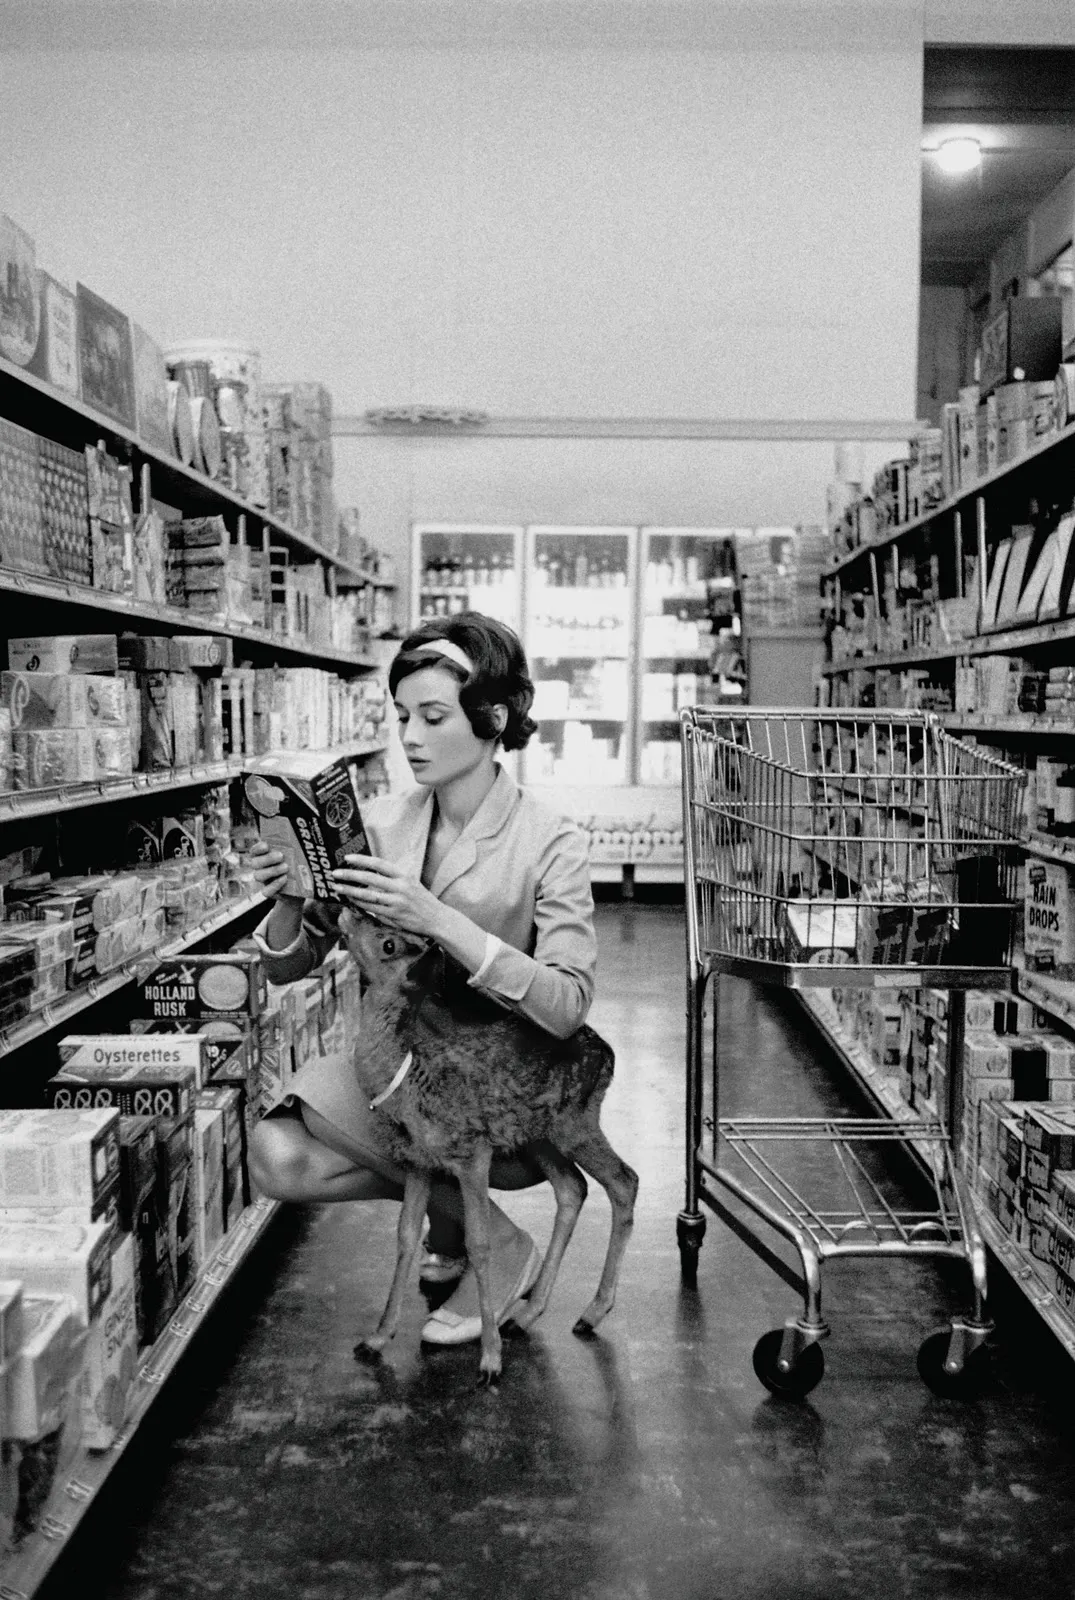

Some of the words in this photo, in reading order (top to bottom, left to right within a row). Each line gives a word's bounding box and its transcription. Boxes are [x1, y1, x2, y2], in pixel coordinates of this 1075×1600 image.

[296, 816, 329, 898] GRAHAMS
[1033, 882, 1056, 907] RAIN
[1029, 906, 1059, 932] DROPS
[144, 985, 196, 1001] HOLLAND
[153, 1001, 187, 1017] RUSK
[93, 1048, 181, 1064] Oysterettes
